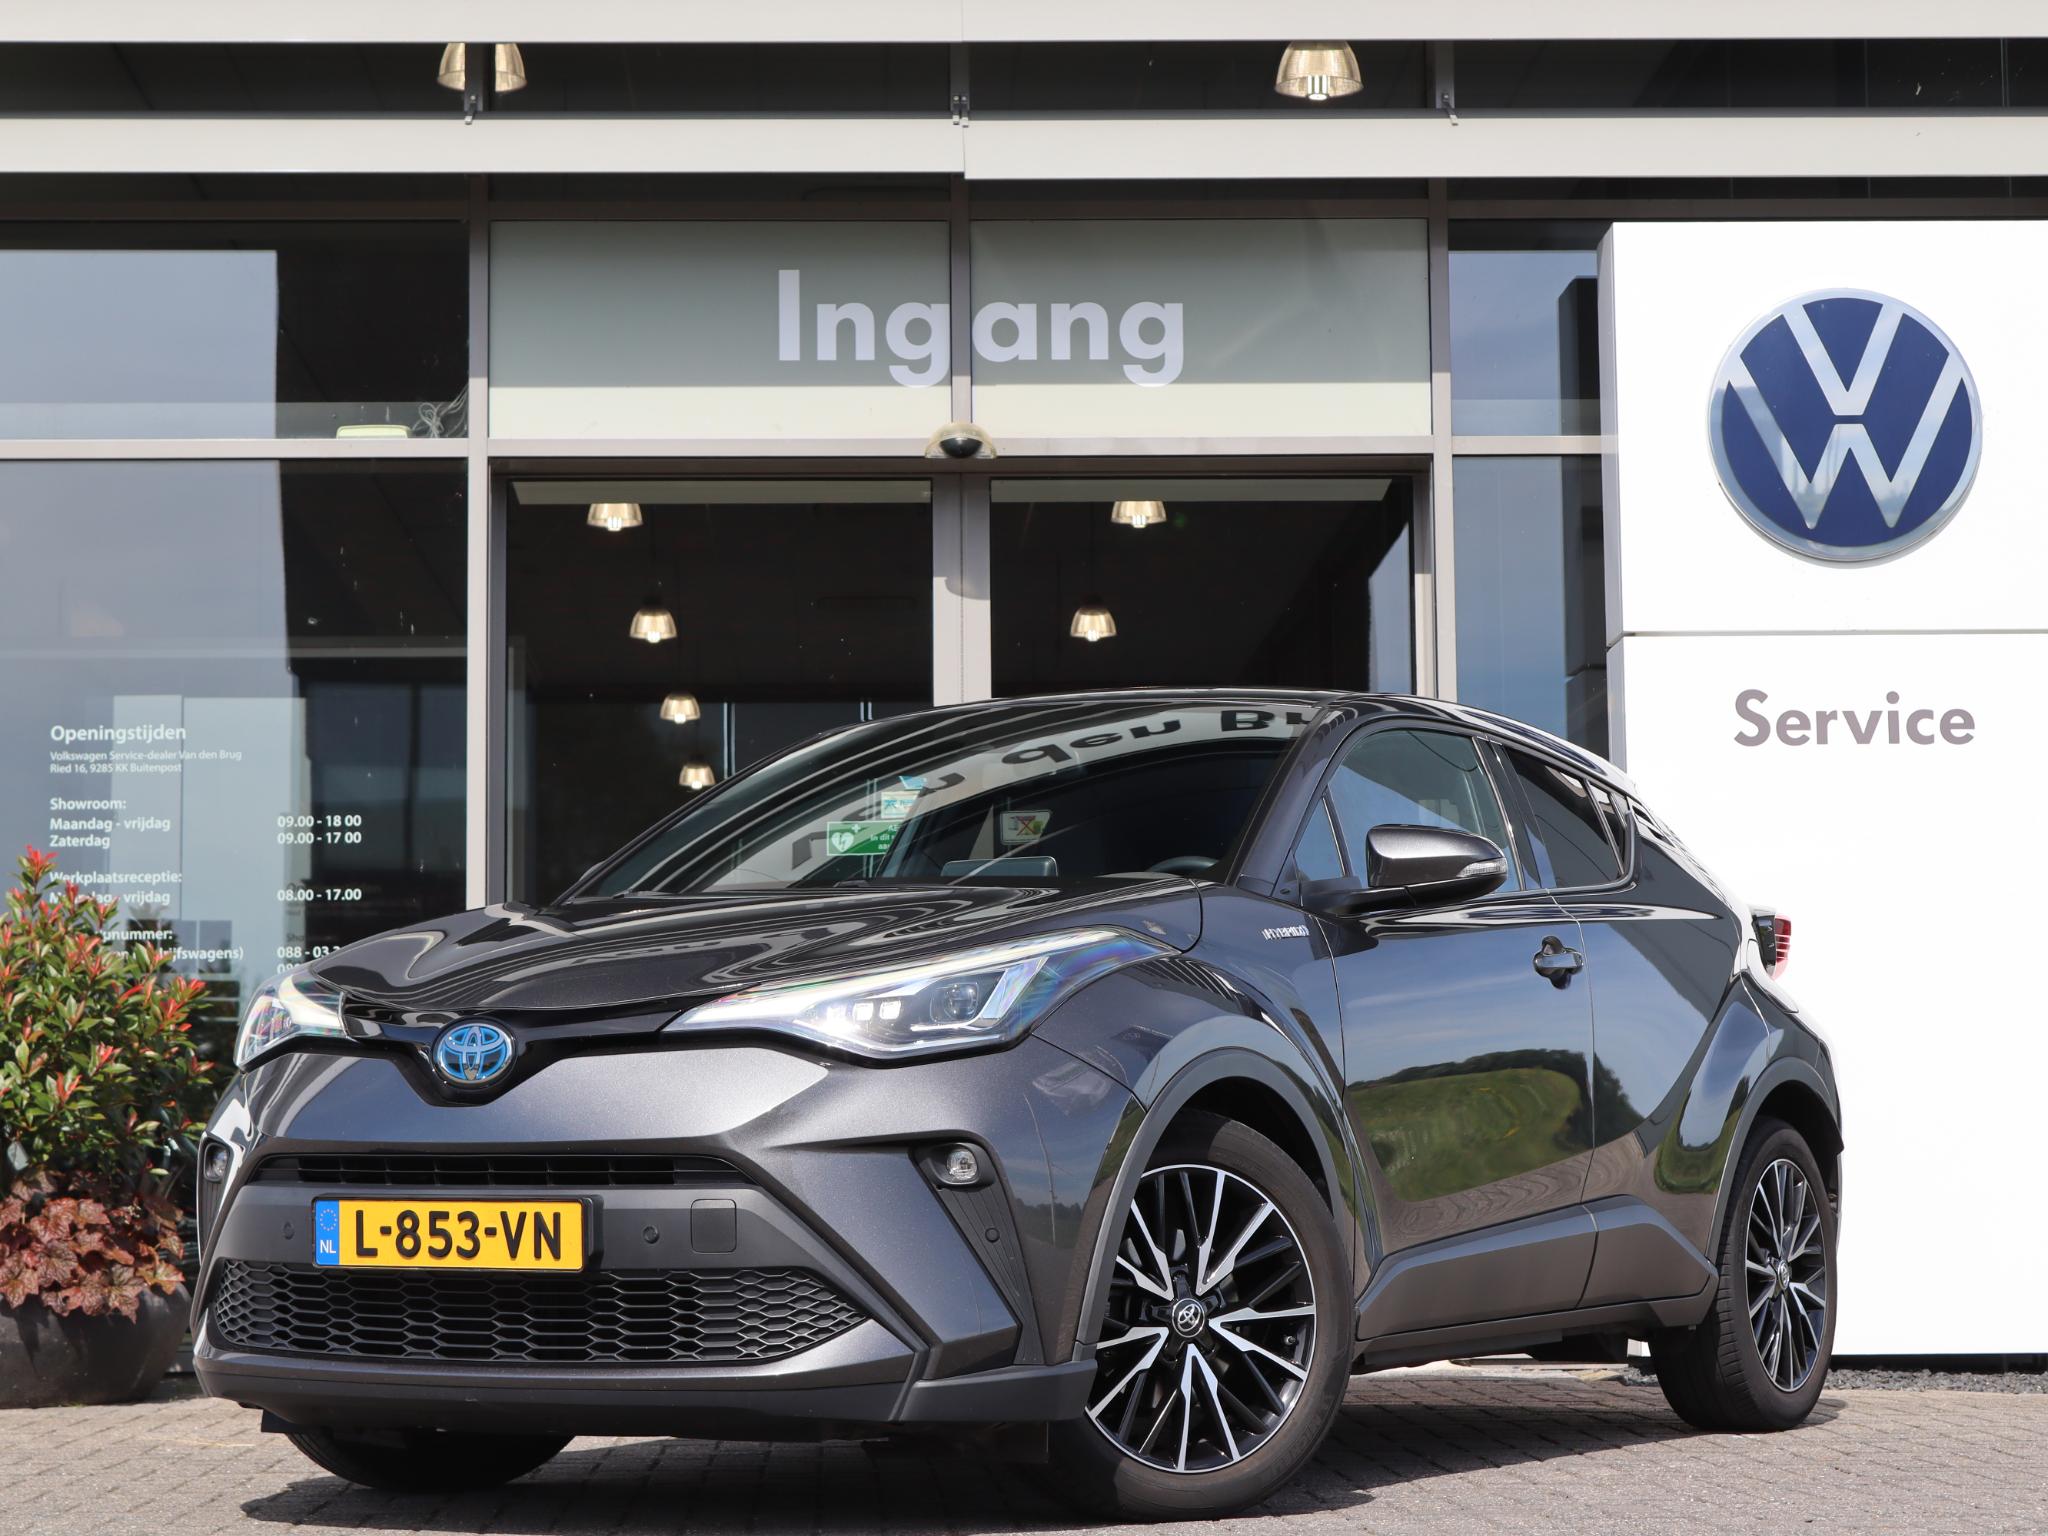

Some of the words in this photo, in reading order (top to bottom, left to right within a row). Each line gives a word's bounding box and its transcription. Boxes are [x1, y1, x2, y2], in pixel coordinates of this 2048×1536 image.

[778, 269, 1184, 388] Ingang
[1734, 688, 1976, 747] Service
[50, 724, 186, 743] Openingstijden
[50, 750, 107, 762] Volkswagen
[109, 750, 177, 761] Service-dealer
[178, 750, 196, 760] Van
[198, 750, 216, 760] den
[219, 749, 242, 761] Brug
[50, 763, 72, 773] Ried
[89, 763, 113, 773] 9285
[115, 763, 129, 772] KK
[130, 762, 182, 774] Buitenpost
[50, 797, 127, 810] Showroom:
[50, 817, 113, 832] Maandag
[123, 816, 171, 832] vrijdag
[277, 815, 315, 827] 09.00
[50, 834, 111, 849] Zaterdag
[277, 831, 315, 844] 09.00
[50, 870, 183, 886] Werkplaatsreceptie:
[123, 890, 171, 906] vrijdag
[277, 888, 315, 901] 08.00
[325, 888, 362, 901] 17.00
[277, 946, 303, 959] 088
[319, 1239, 337, 1254] NL
[355, 1209, 562, 1260] L-853-VN
